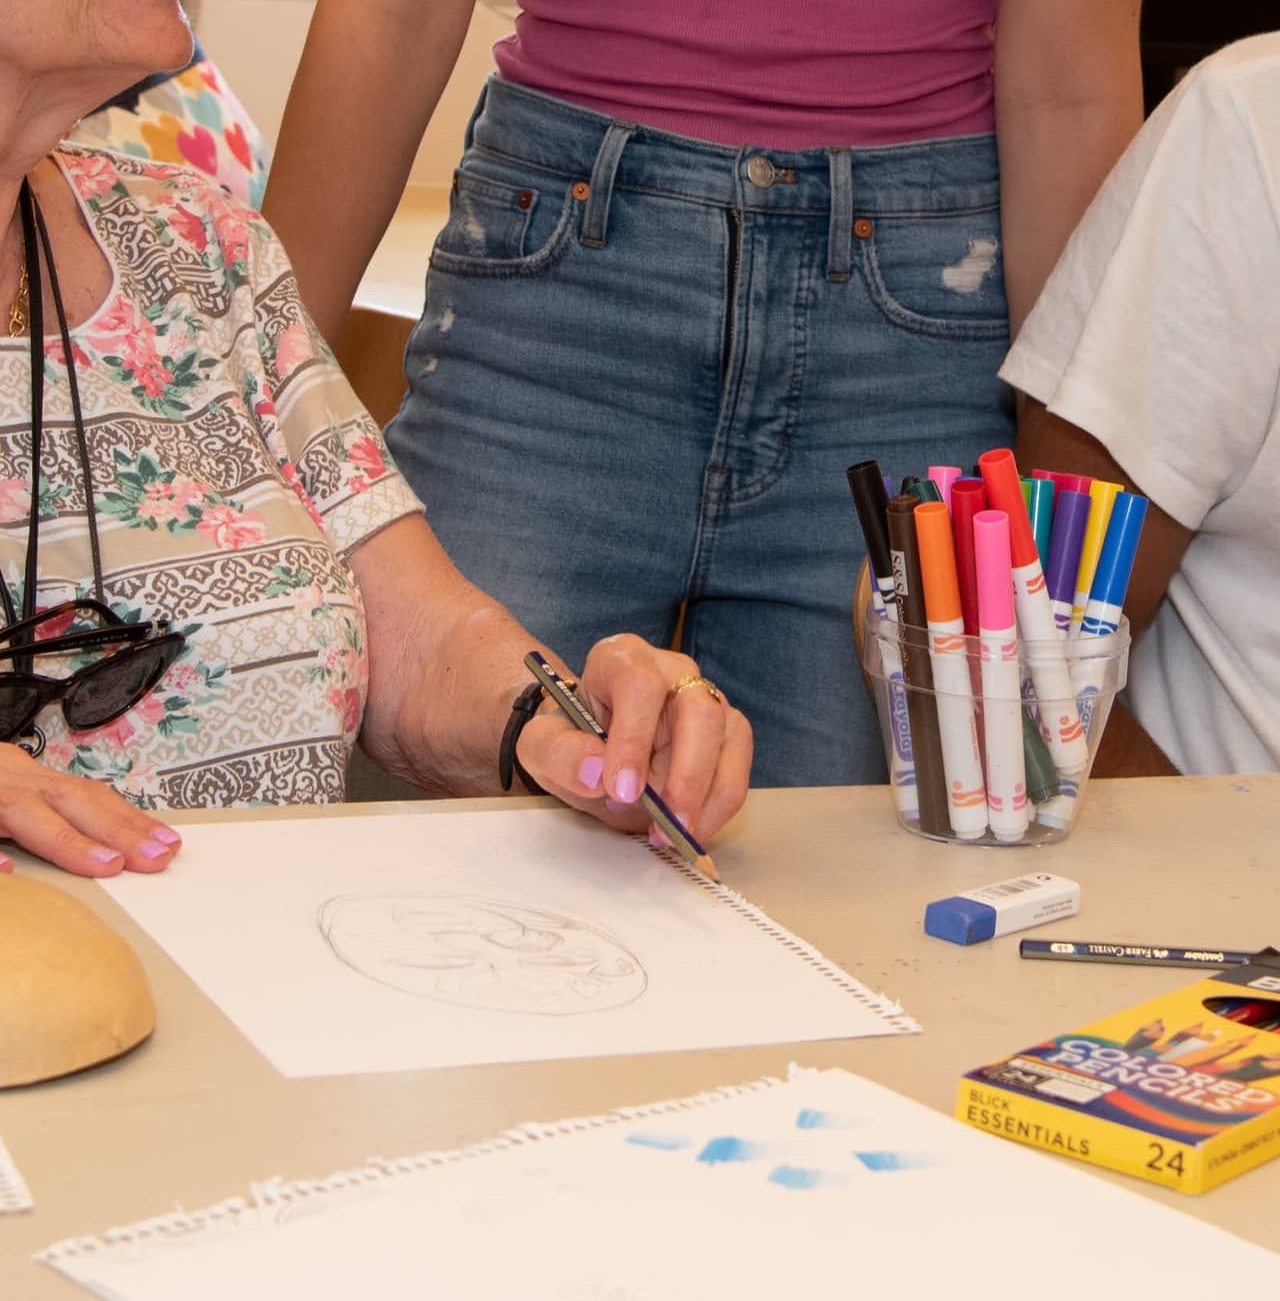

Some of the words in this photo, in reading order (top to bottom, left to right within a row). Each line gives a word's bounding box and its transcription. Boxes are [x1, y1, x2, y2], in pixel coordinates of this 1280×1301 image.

[1046, 1051, 1245, 1114] PENCILS
[1060, 1039, 1276, 1104] COLORED
[969, 1088, 1011, 1112] BLICK
[966, 1105, 1092, 1156] ESSENTIALS
[1146, 1143, 1186, 1178] 24
